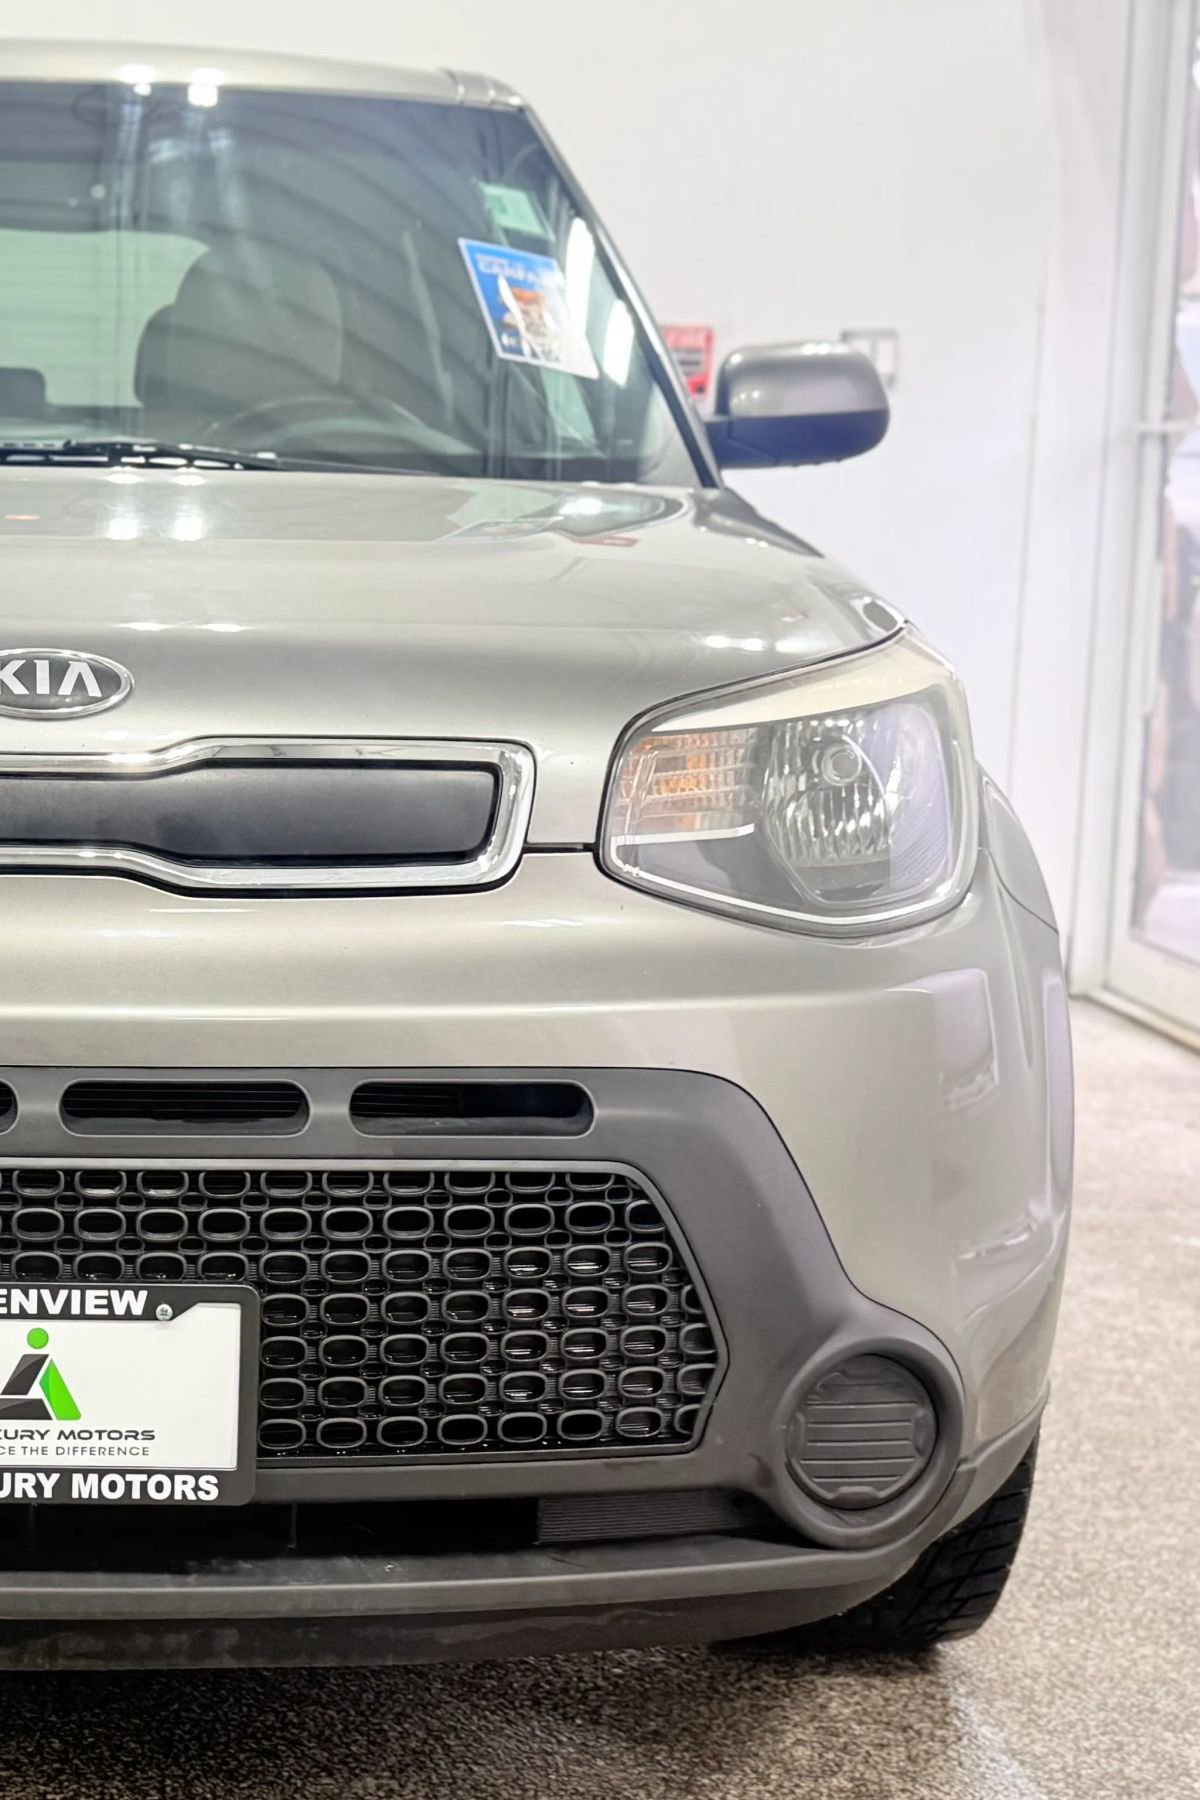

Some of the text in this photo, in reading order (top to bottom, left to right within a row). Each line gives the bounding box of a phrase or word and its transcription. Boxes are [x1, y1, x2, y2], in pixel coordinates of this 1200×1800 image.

[57, 1429, 156, 1442] MOTORS
[20, 1446, 48, 1456] THE
[55, 1446, 149, 1456] DIFFERENCE
[71, 1473, 219, 1501] MOTORS
